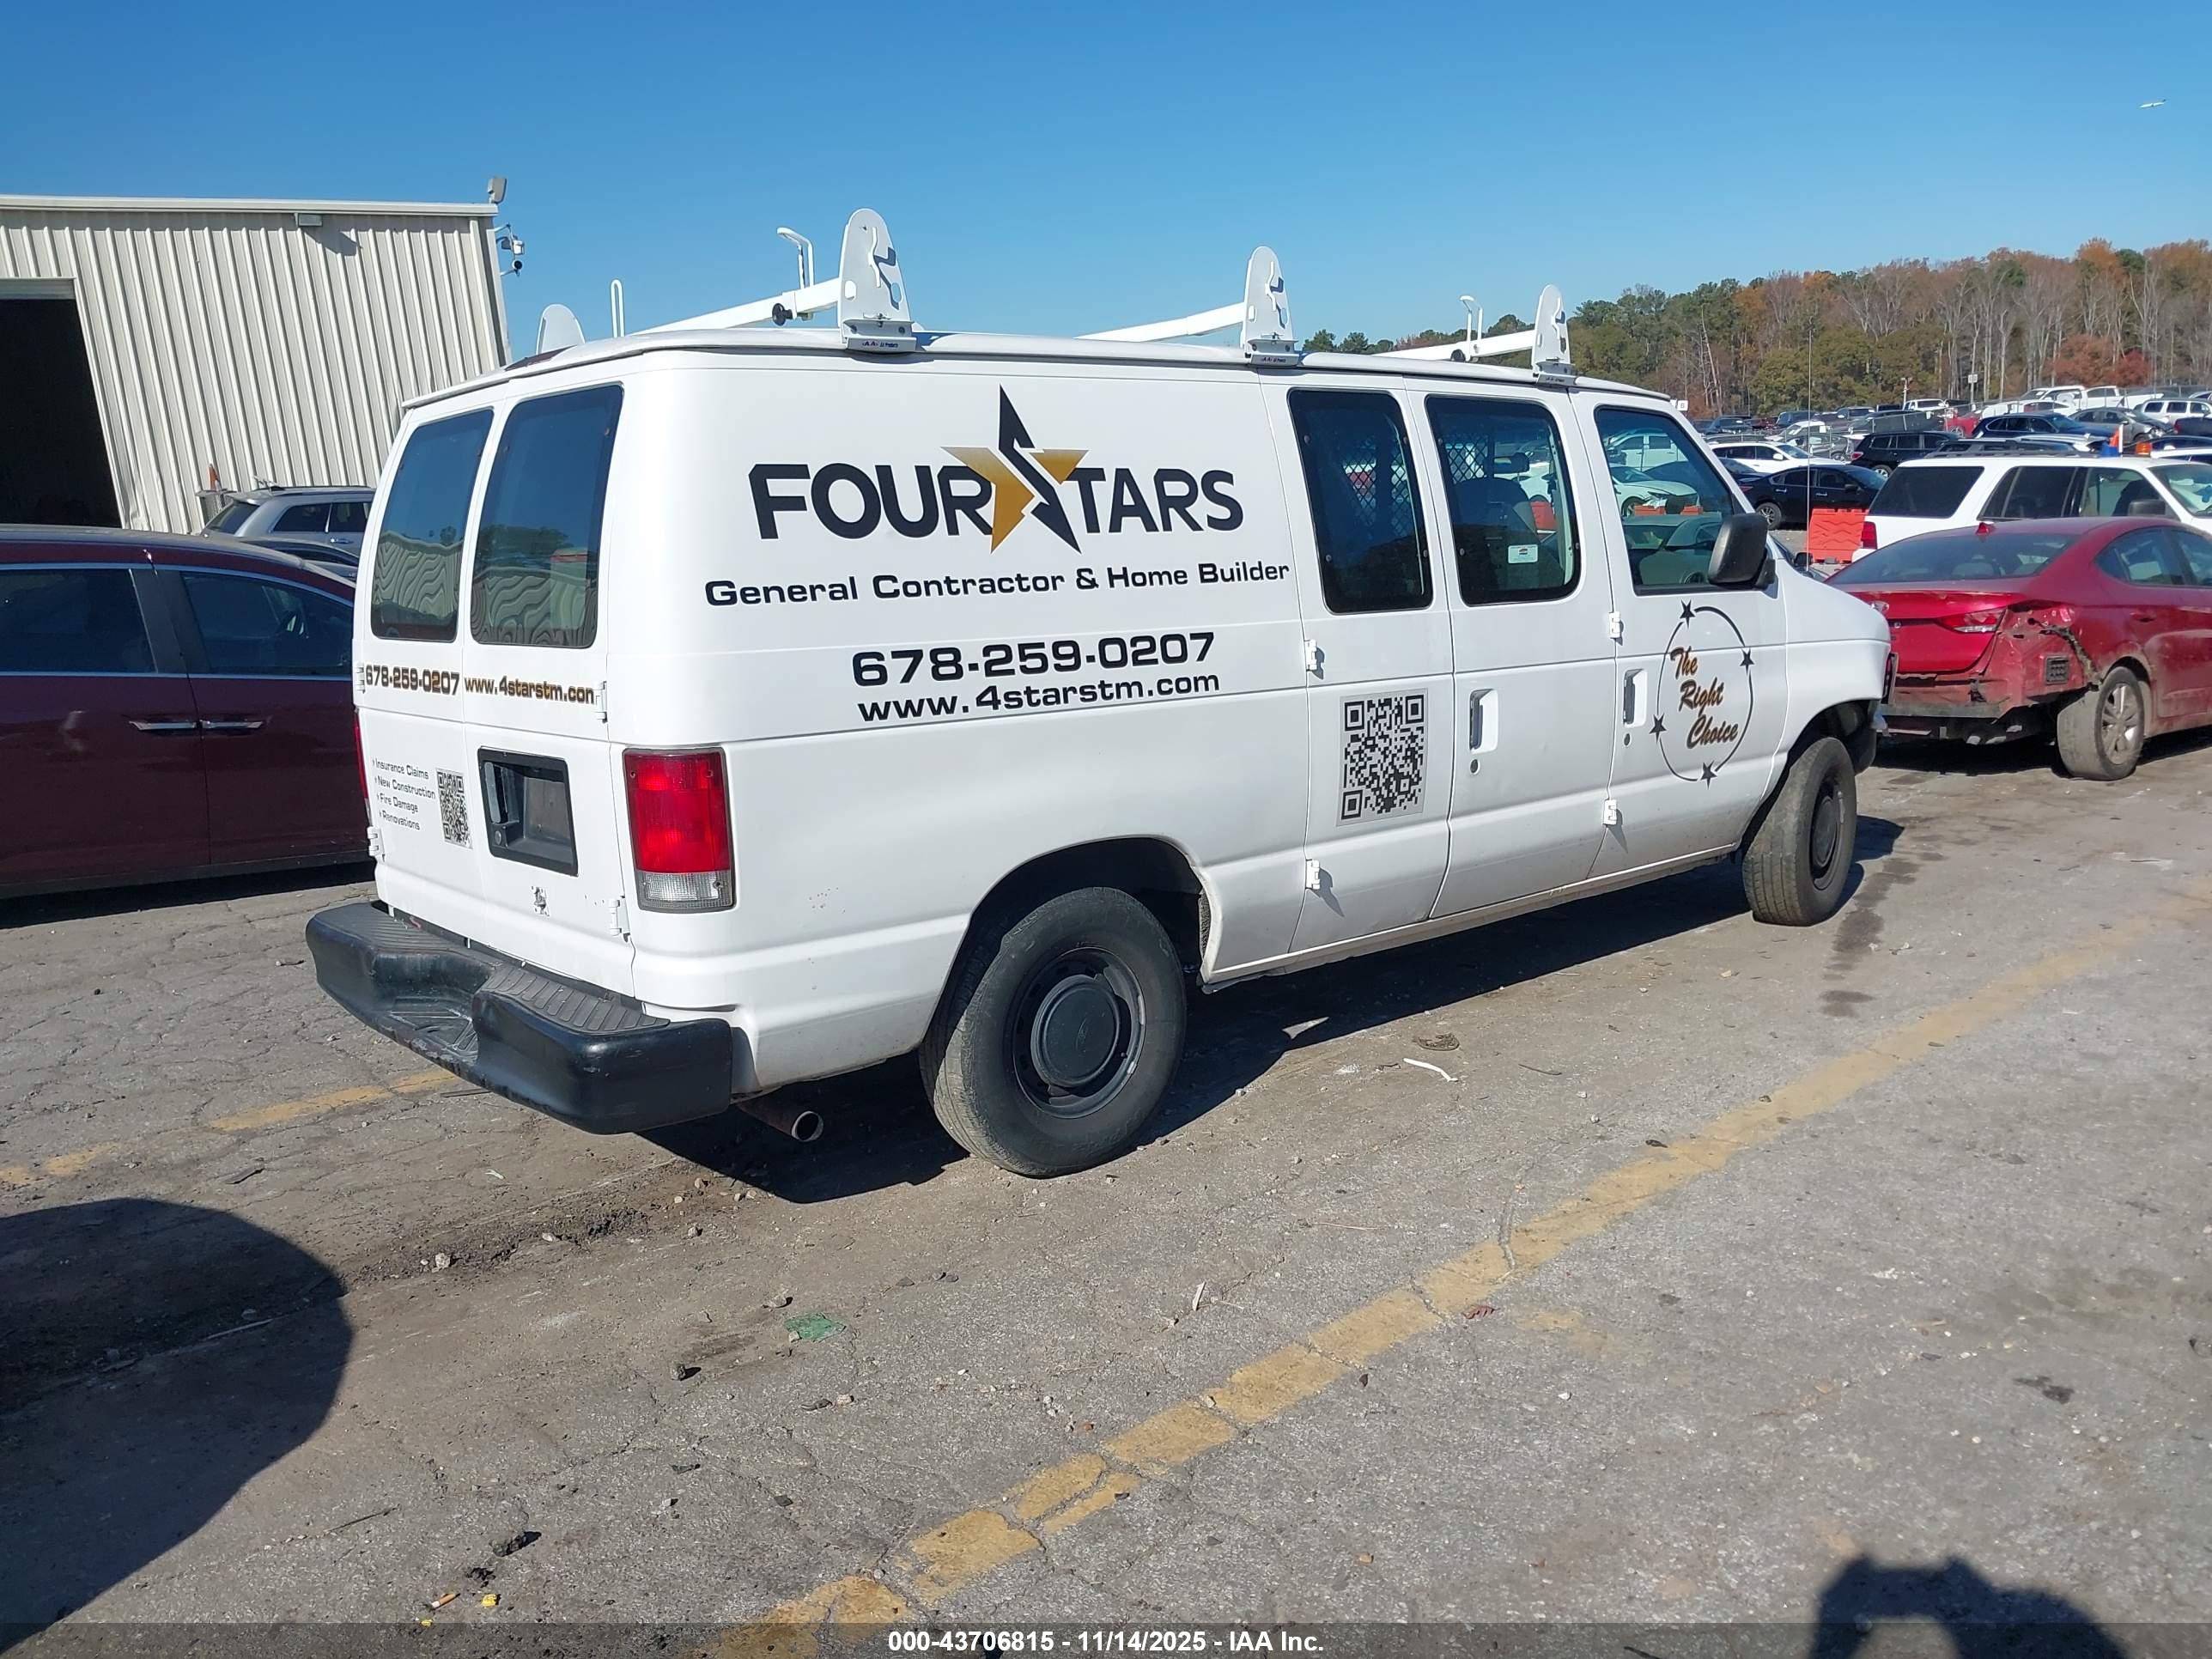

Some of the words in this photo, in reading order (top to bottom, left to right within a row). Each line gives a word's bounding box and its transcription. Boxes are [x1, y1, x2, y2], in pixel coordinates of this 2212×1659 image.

[748, 462, 994, 539] FOUR
[705, 576, 858, 606] General
[872, 573, 1065, 599] Contractor
[1076, 568, 1099, 590] &
[1106, 566, 1188, 588] Home
[1198, 561, 1290, 584] Builder
[852, 631, 1214, 686] 678-259-0207
[1670, 646, 1698, 679] The
[365, 664, 459, 696] 678-259-0207
[1679, 677, 1724, 715] Right
[858, 674, 1219, 722] www.4starstm.com
[1686, 714, 1739, 750] Choice
[374, 757, 405, 775] Insurance
[406, 764, 429, 780] Claims
[378, 775, 390, 788] New
[392, 779, 436, 799] Construction
[380, 793, 392, 805] Fire
[393, 796, 418, 814] Damage
[382, 810, 420, 830] Renovations
